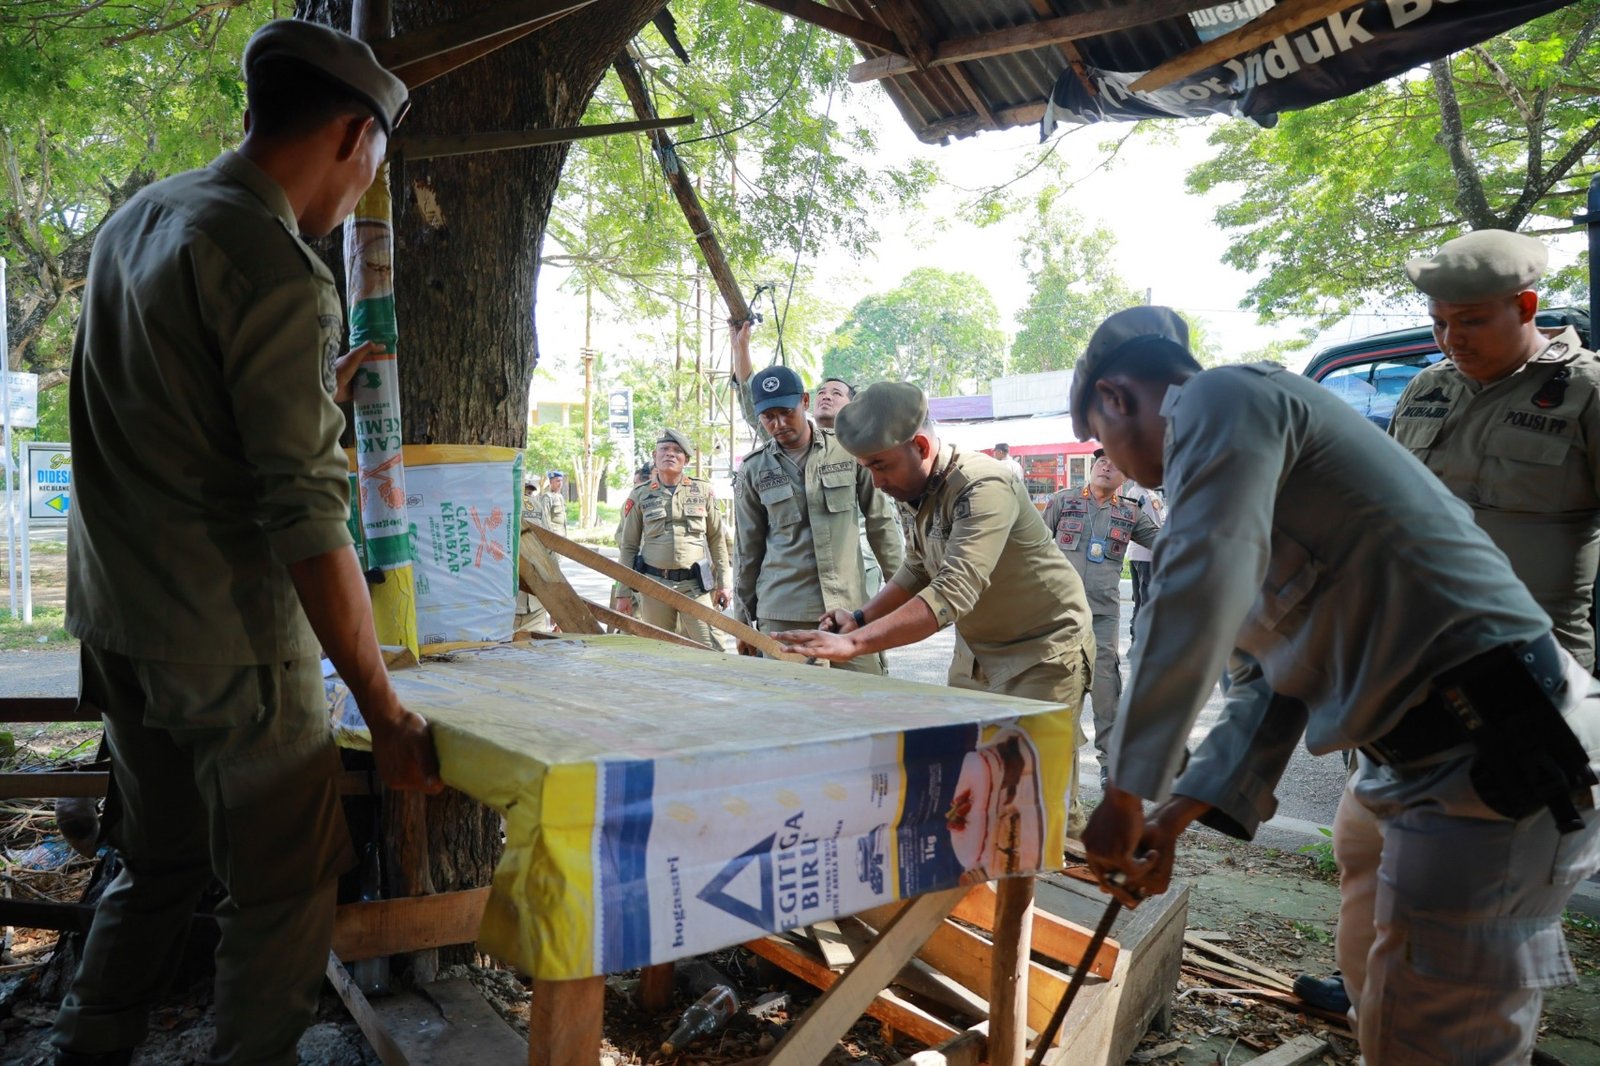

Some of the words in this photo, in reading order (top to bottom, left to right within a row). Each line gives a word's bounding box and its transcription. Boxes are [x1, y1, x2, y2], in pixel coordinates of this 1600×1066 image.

[1503, 411, 1547, 429] POLISI
[1548, 417, 1568, 434] PP
[440, 501, 460, 573] KEMBAR
[456, 505, 472, 568] CAKRA
[667, 856, 685, 948] bogasari
[801, 837, 820, 910] BIRU
